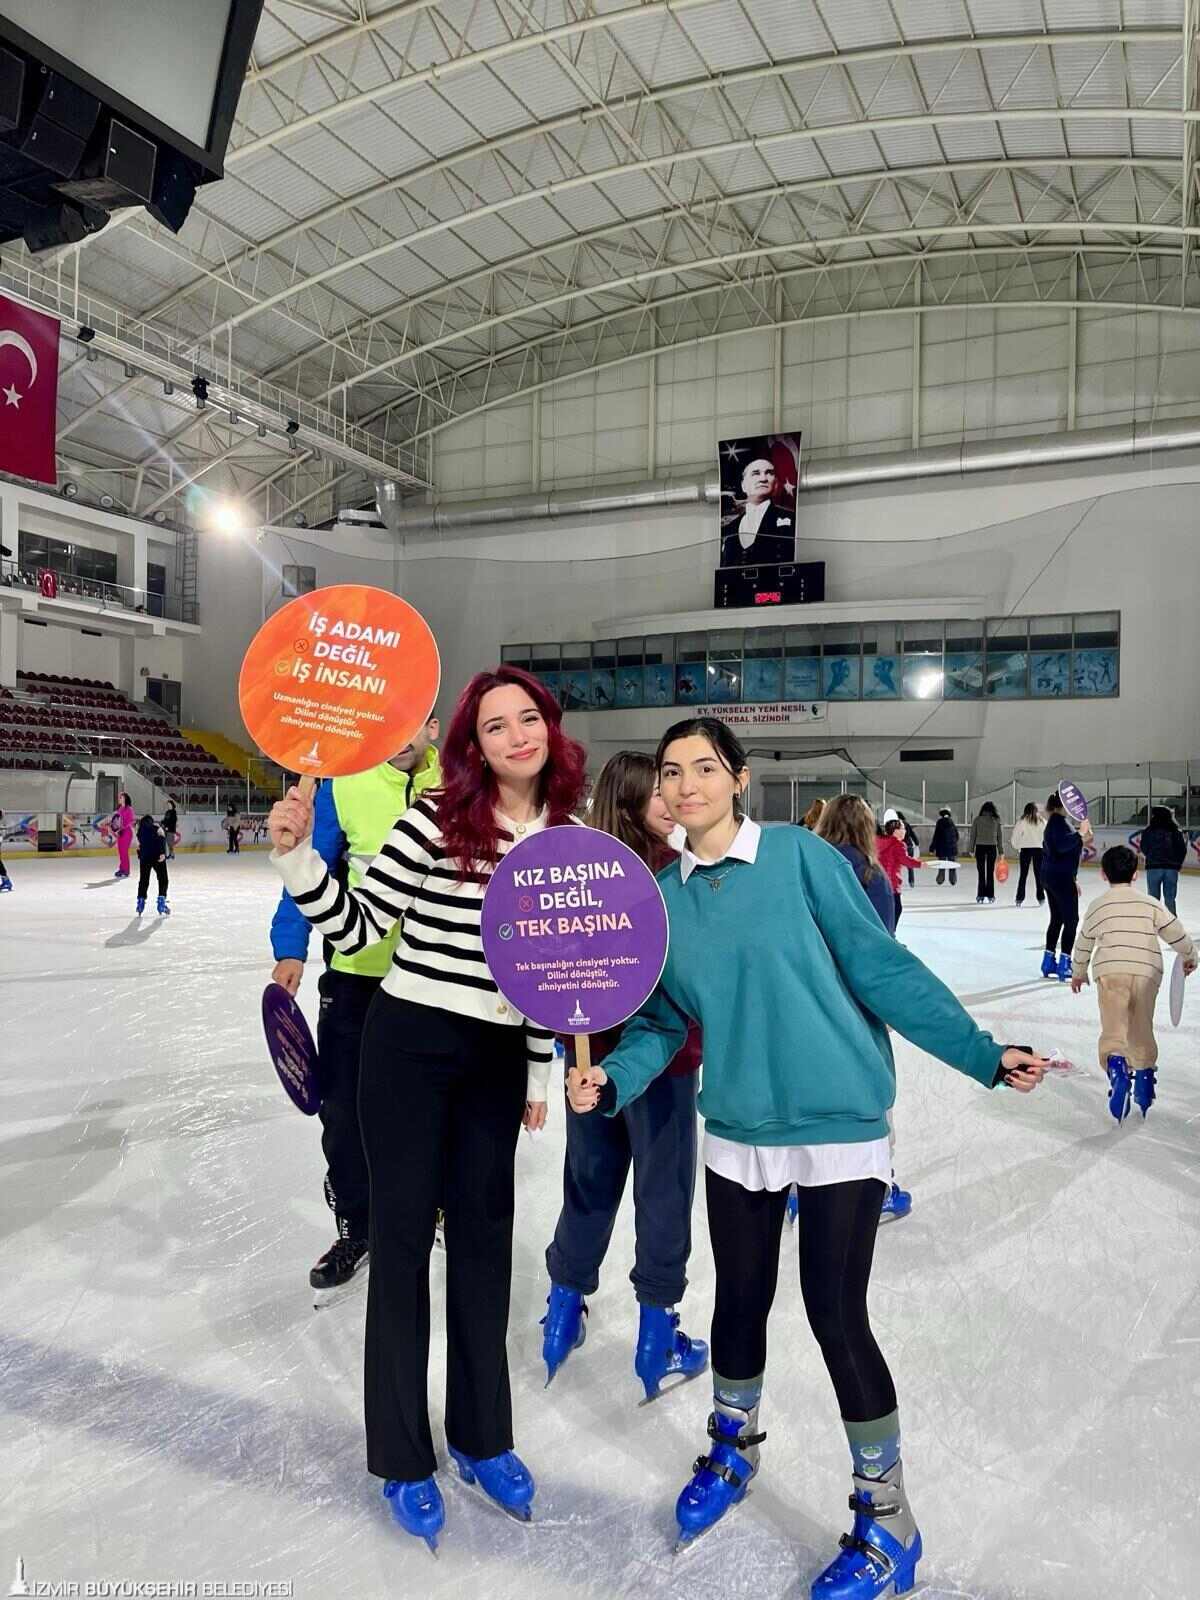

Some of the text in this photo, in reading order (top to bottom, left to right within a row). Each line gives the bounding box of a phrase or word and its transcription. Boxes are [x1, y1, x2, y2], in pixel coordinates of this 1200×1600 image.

[308, 611, 401, 649] İŞ ADAMI
[313, 641, 378, 671] DEĞİL,
[292, 657, 387, 695] İŞ İNSANI
[272, 692, 386, 723] Uzmanlığın cinsiyeti yoktur.
[294, 707, 318, 719] Dilini
[712, 705, 756, 714] YÜKSELEN
[758, 704, 779, 713] YENİ
[780, 703, 807, 712] NESİL
[280, 715, 324, 731] zihniyetini
[513, 861, 626, 888] KIZ BAŞINA
[539, 885, 603, 911] DEĞİL,
[516, 912, 633, 937] TEK BAŞINA
[515, 956, 641, 972] Tek başınalığın cinsiyeti yoktur.
[547, 970, 569, 980] Dilini
[537, 978, 620, 992] zihniyetini dönüştür.
